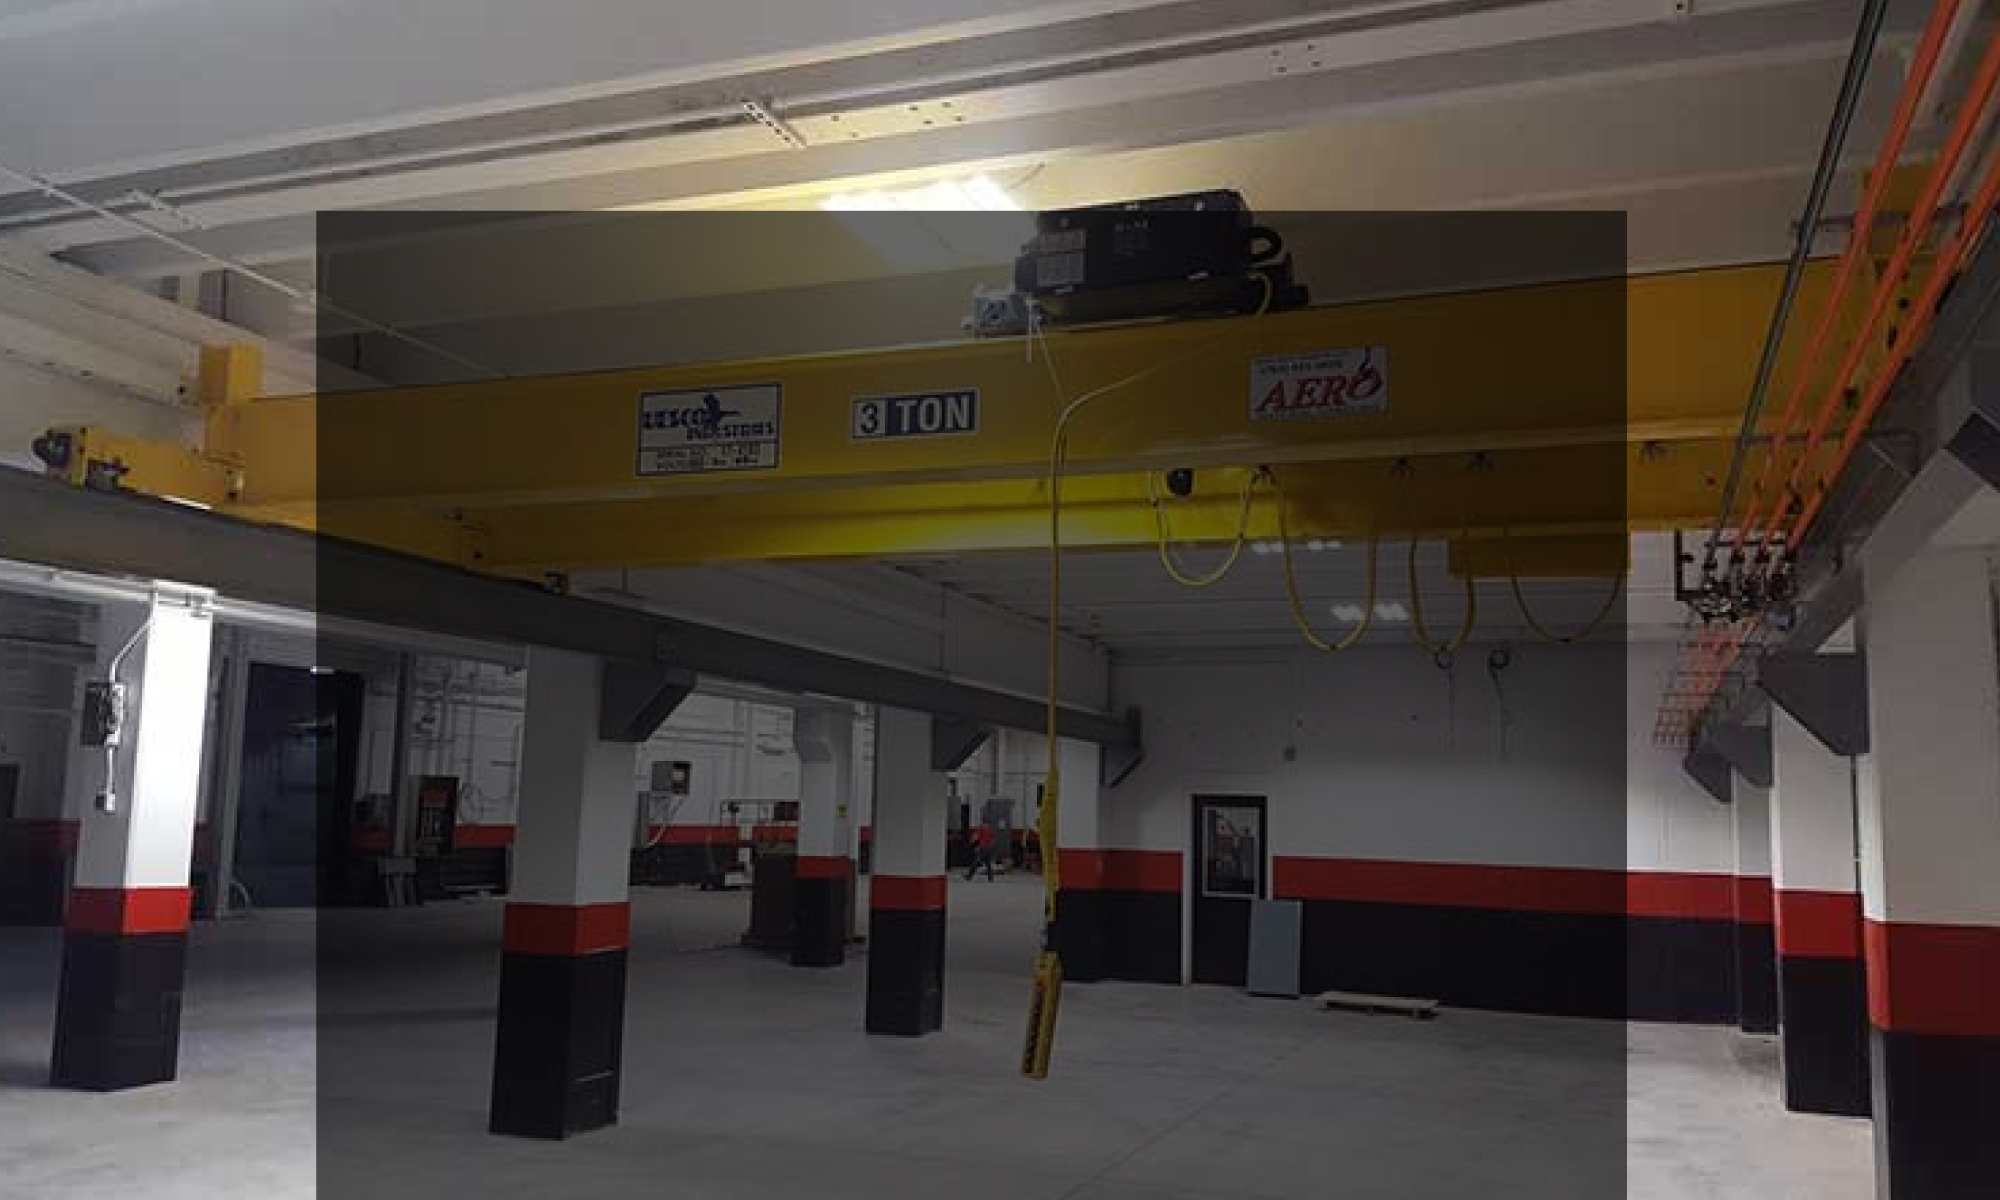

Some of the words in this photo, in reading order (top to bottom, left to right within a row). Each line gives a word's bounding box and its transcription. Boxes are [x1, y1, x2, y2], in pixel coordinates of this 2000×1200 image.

[1254, 366, 1384, 412] AERO
[860, 403, 878, 434] 3
[895, 395, 971, 434] TON
